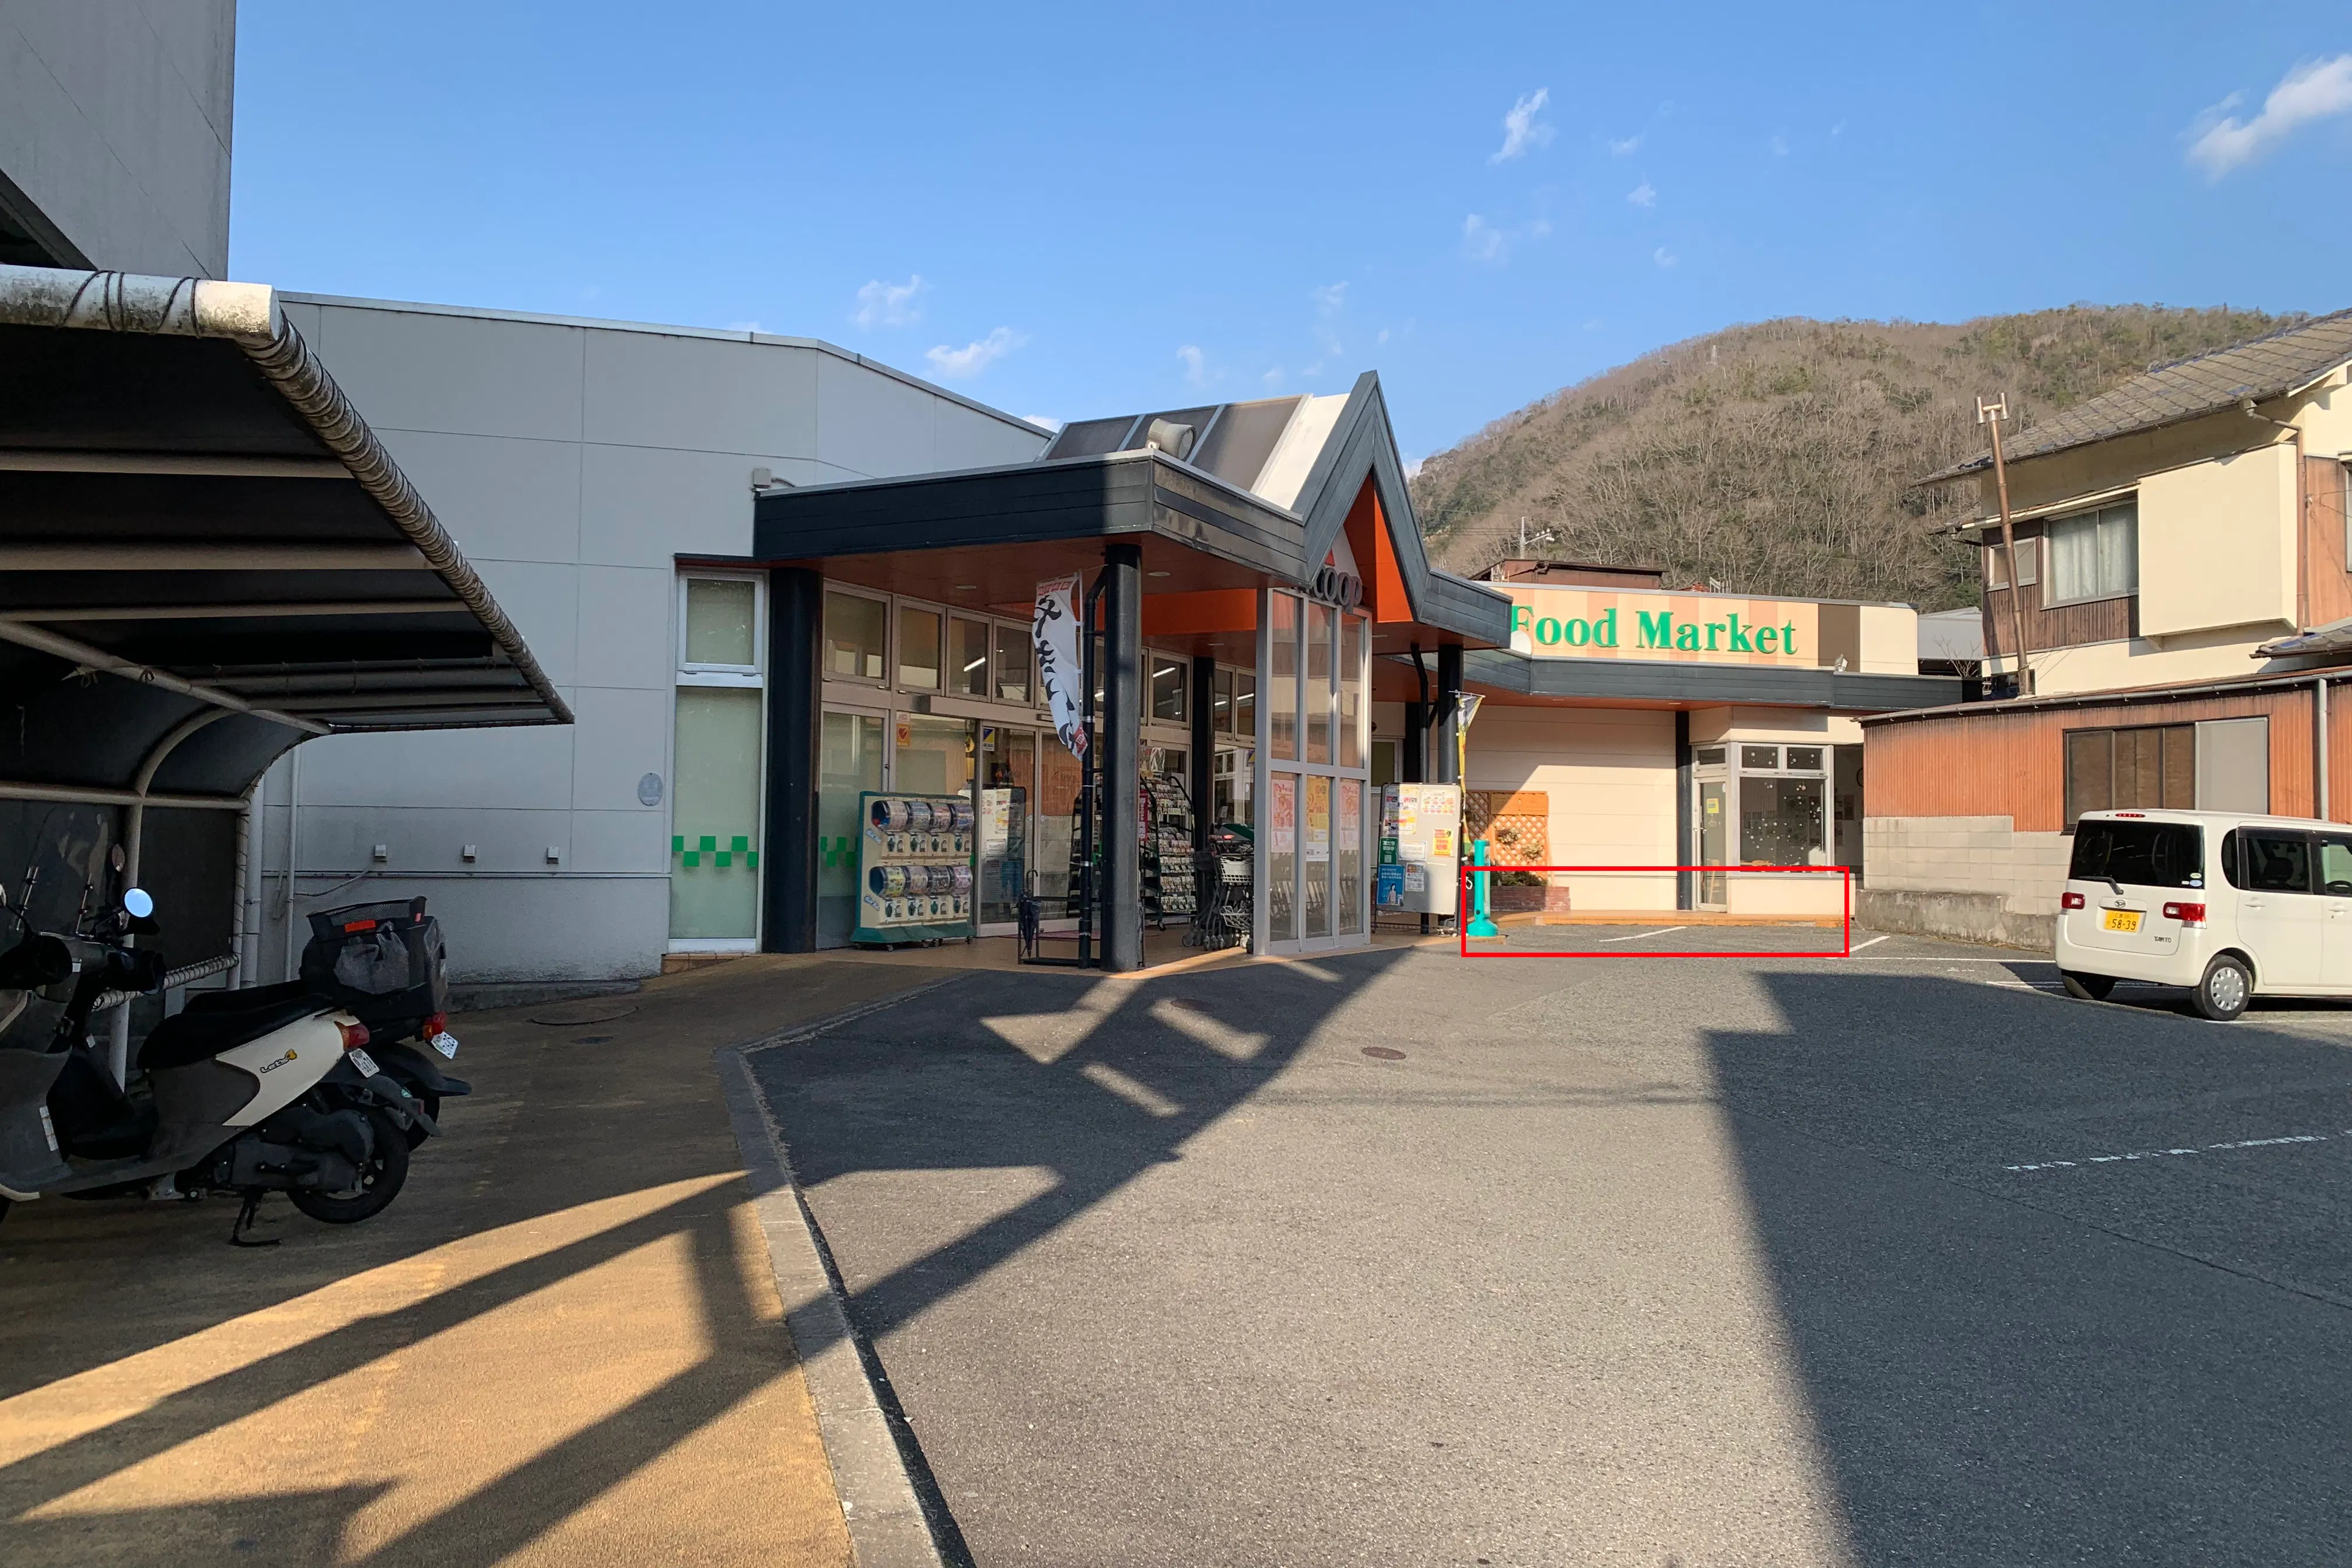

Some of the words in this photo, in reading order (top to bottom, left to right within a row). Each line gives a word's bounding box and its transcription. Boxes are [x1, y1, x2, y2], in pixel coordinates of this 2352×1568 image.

[1511, 605, 1619, 648] Food
[1636, 610, 1798, 654] Market
[2112, 919, 2136, 930] 58-39
